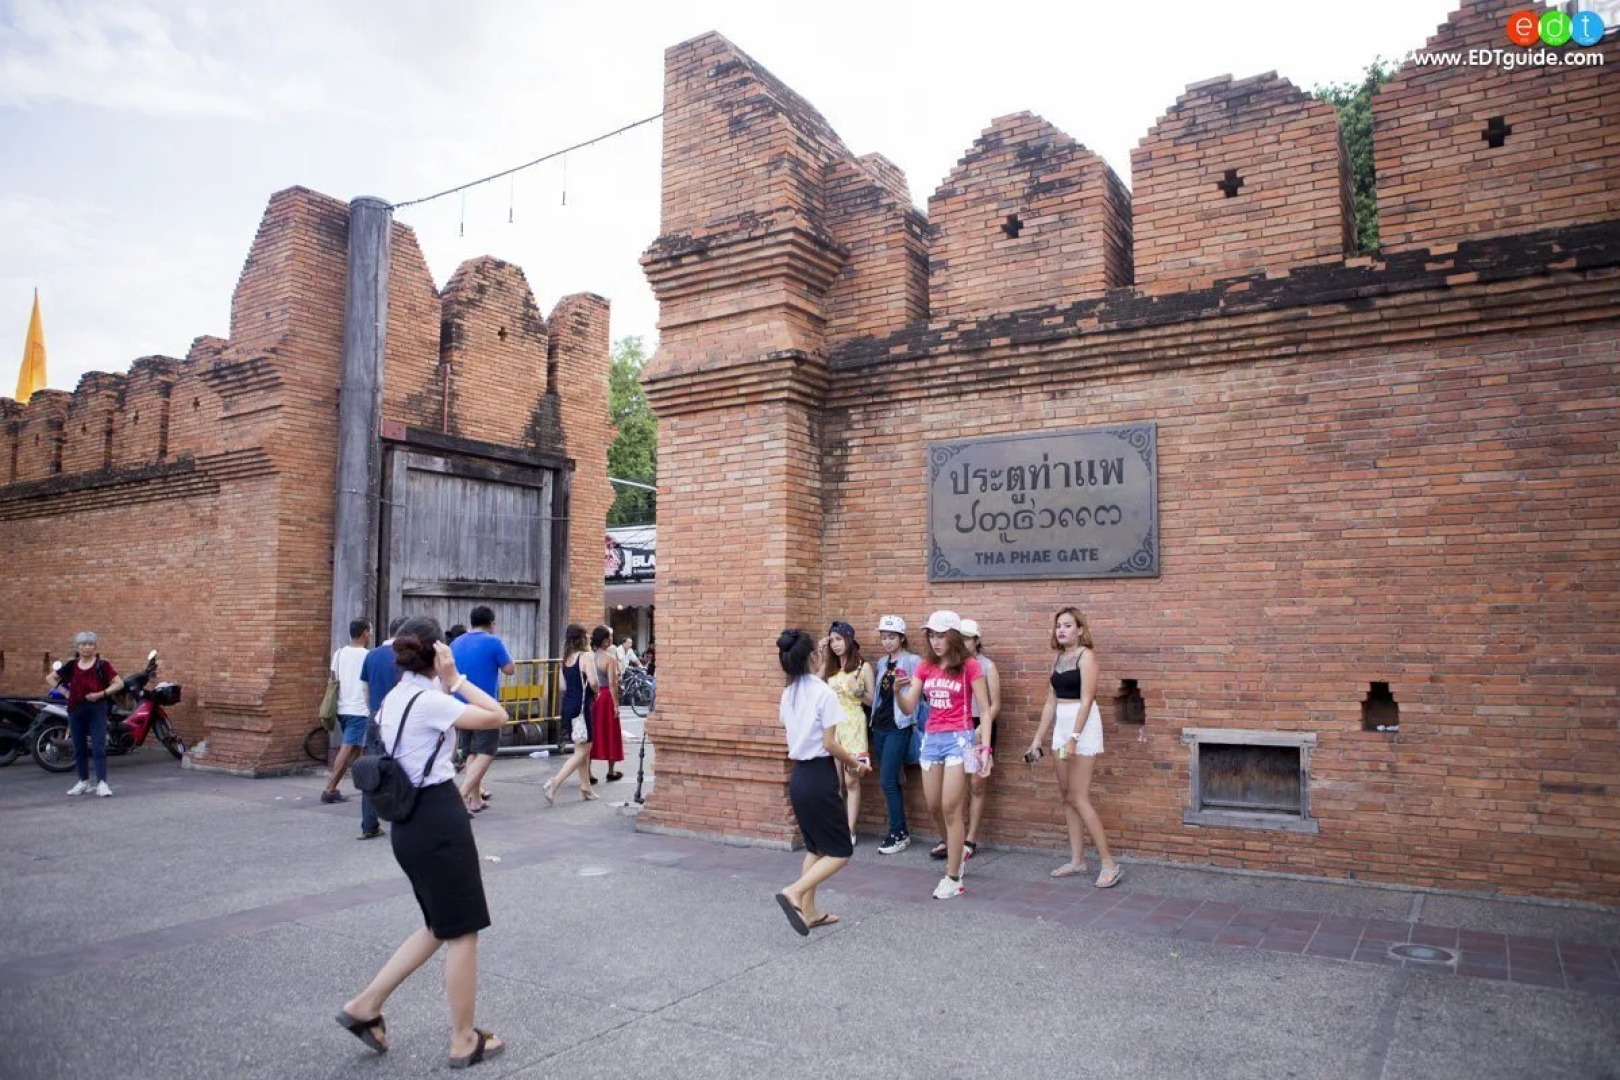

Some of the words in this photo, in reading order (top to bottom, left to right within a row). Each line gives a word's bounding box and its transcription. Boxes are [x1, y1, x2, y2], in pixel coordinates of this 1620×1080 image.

[950, 453, 1124, 505] ประตูท่าแพ
[975, 551, 1006, 565] THA
[1010, 550, 1051, 564] PHAE
[1057, 548, 1100, 562] GATE
